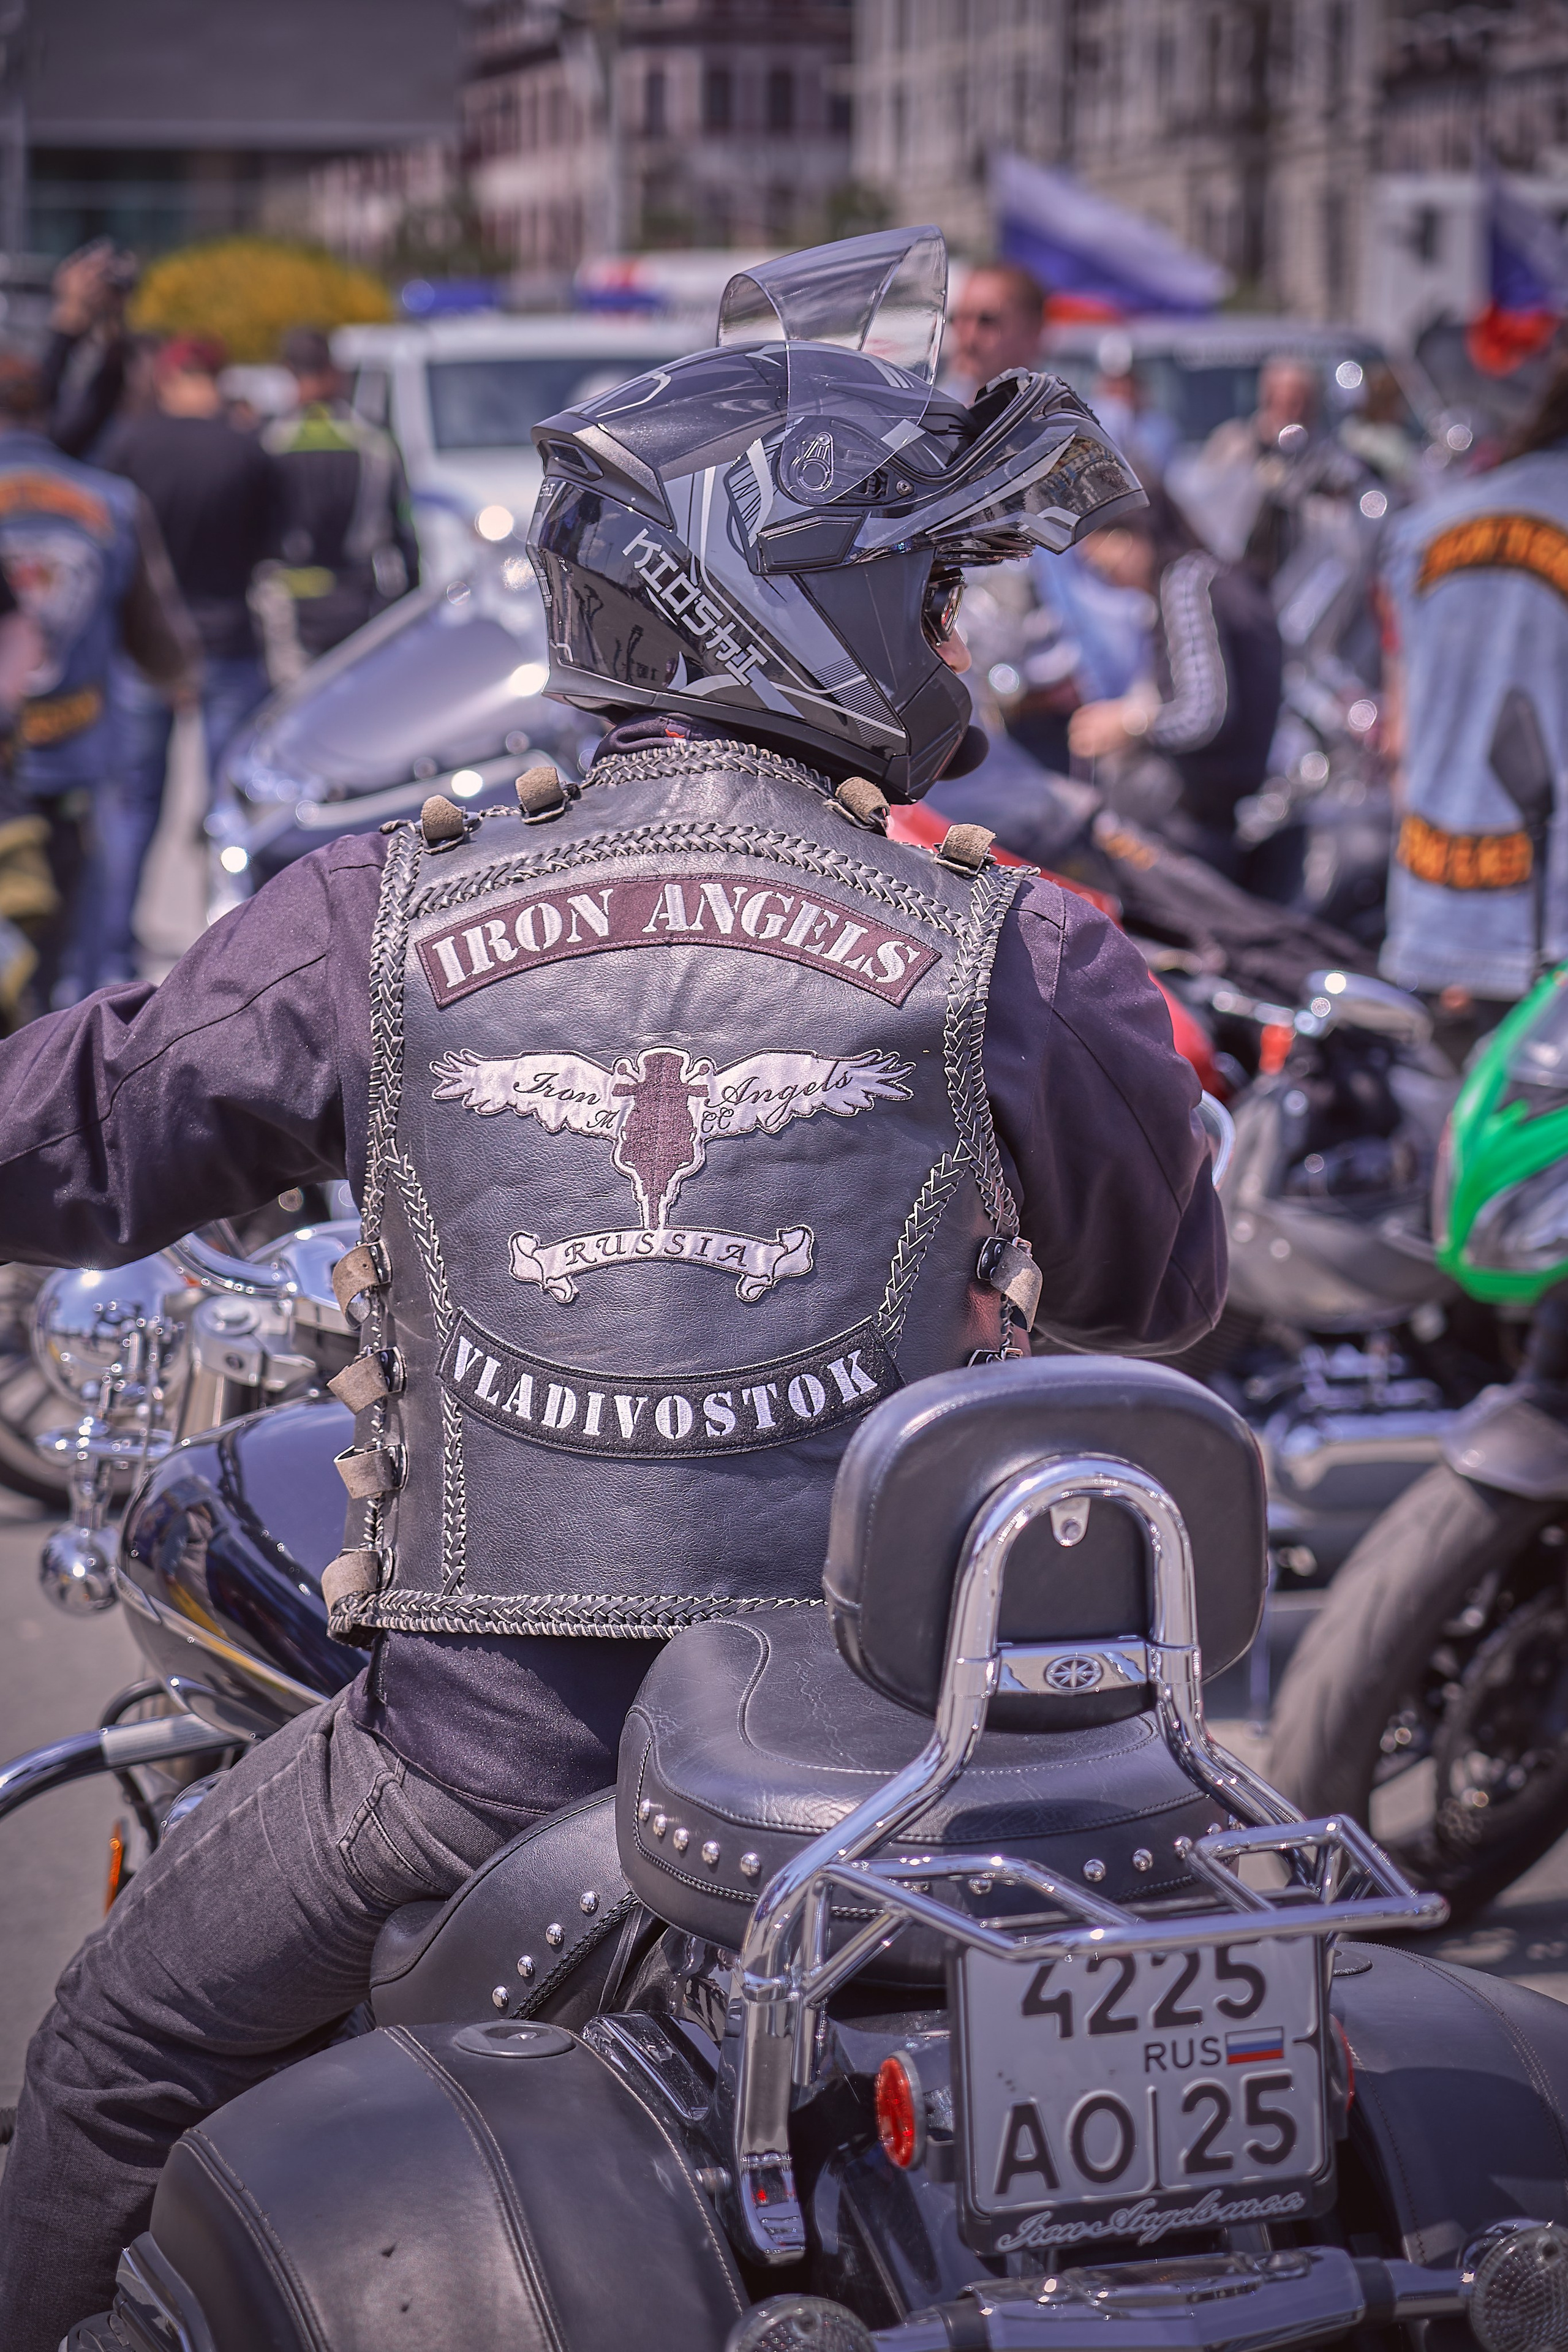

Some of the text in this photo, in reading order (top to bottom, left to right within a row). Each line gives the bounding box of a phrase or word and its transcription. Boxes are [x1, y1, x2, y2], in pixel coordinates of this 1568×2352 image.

[432, 883, 921, 989] IRON ANGELS
[513, 1060, 854, 1125] Iron Angels
[564, 1232, 747, 1267] RUSSIA
[452, 1335, 878, 1439] VLADIVOSTOK
[1021, 1942, 1267, 2038] 4225
[1143, 2035, 1222, 2073] RUS
[1181, 2070, 1298, 2176] 25
[995, 2210, 1093, 2252] Iron
[1093, 2188, 1224, 2247] Angels
